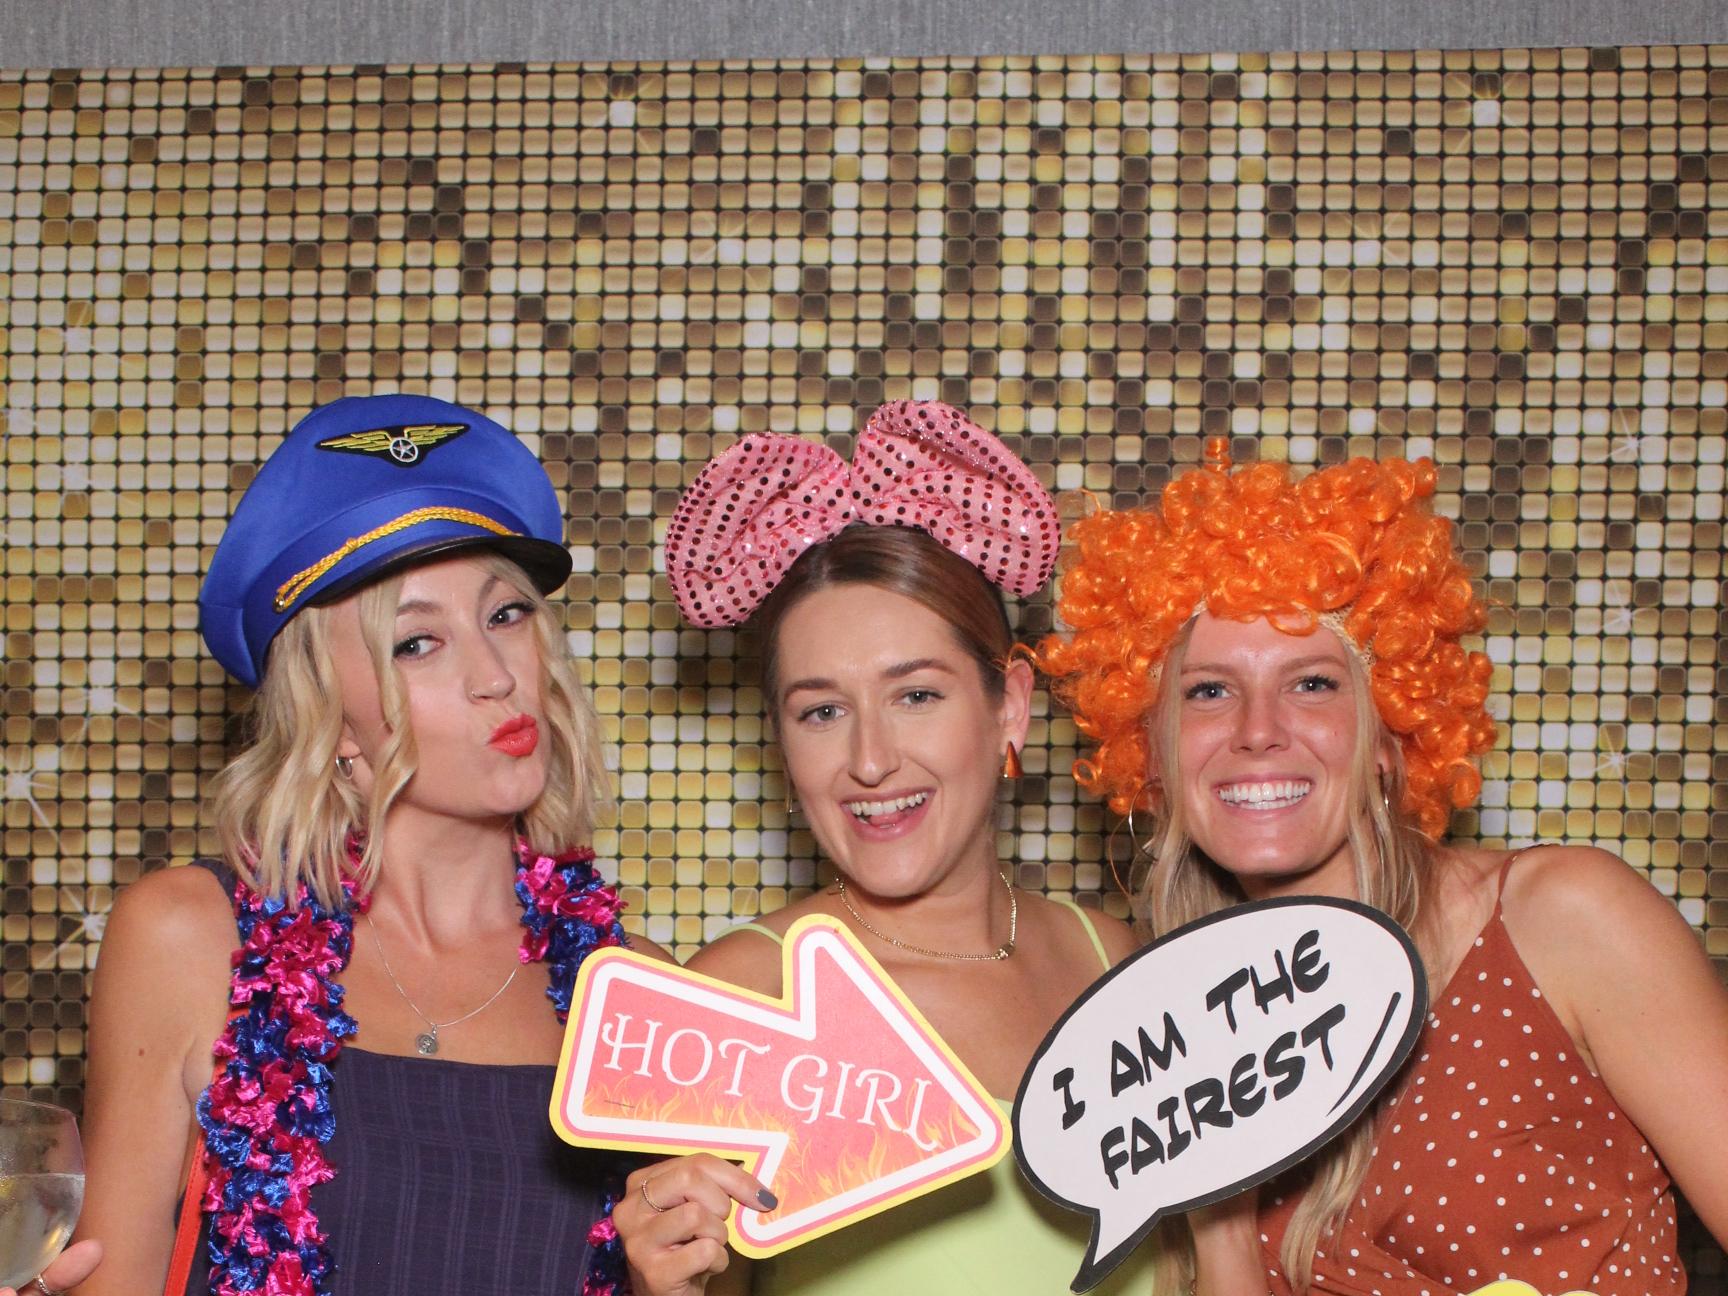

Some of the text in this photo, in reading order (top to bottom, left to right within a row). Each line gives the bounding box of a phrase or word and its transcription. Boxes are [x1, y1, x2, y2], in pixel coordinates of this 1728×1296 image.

[602, 1013, 938, 1151] HOT GIRL
[1053, 929, 1330, 1130] I AM THE
[1100, 1003, 1346, 1190] FAIREST
